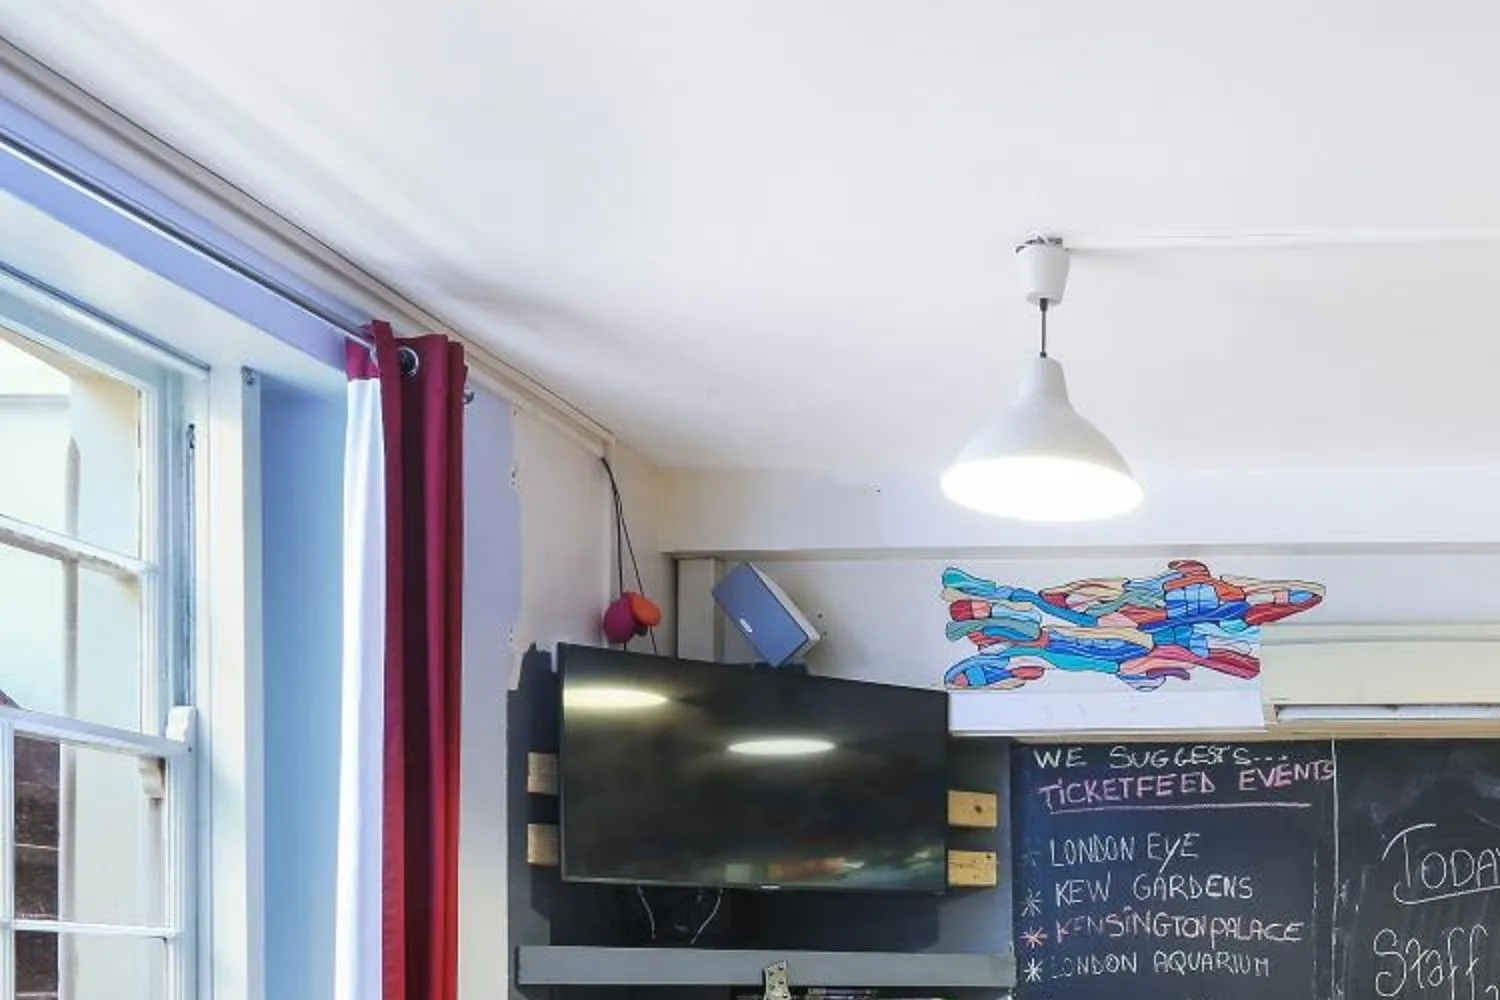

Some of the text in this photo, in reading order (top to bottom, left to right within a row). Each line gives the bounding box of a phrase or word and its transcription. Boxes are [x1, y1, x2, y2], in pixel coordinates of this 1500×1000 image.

[1034, 748, 1087, 769] WE
[1239, 760, 1334, 791] EVENTS
[1050, 832, 1200, 874] LONDON EYE
[1055, 874, 1254, 907] KEW GARDENS
[1153, 950, 1269, 978] AQUARIUM
